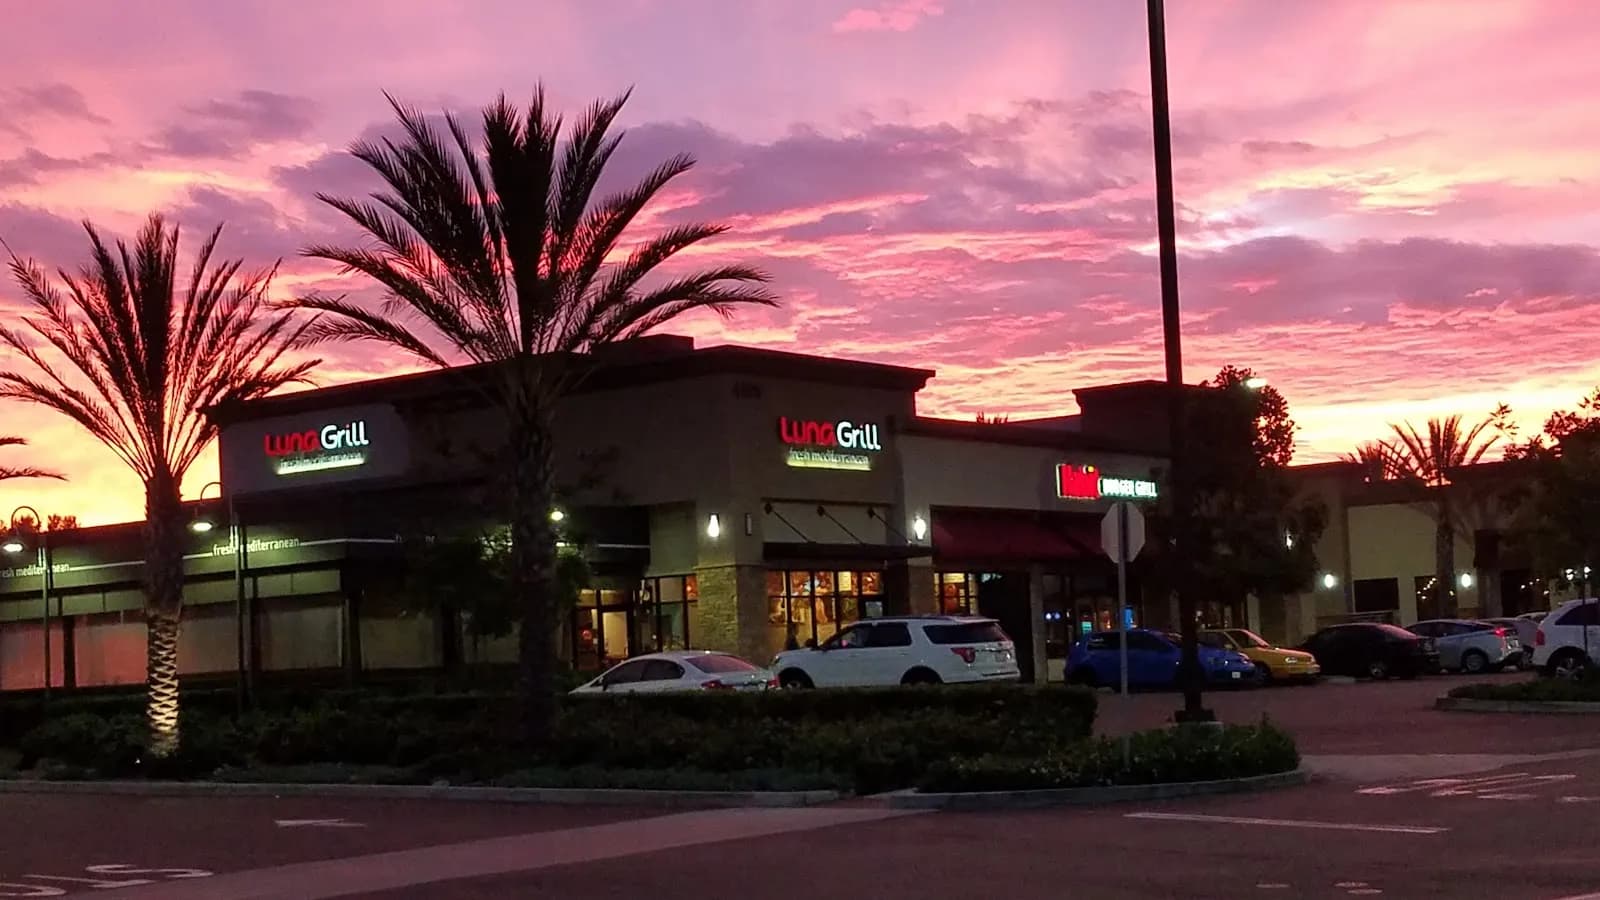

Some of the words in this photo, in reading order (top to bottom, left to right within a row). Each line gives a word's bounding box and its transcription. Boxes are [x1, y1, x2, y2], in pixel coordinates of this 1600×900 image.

[264, 430, 320, 456] Luna
[320, 421, 369, 450] Grill
[780, 415, 837, 446] Luna
[837, 421, 881, 450] Grill
[213, 543, 237, 556] fresh
